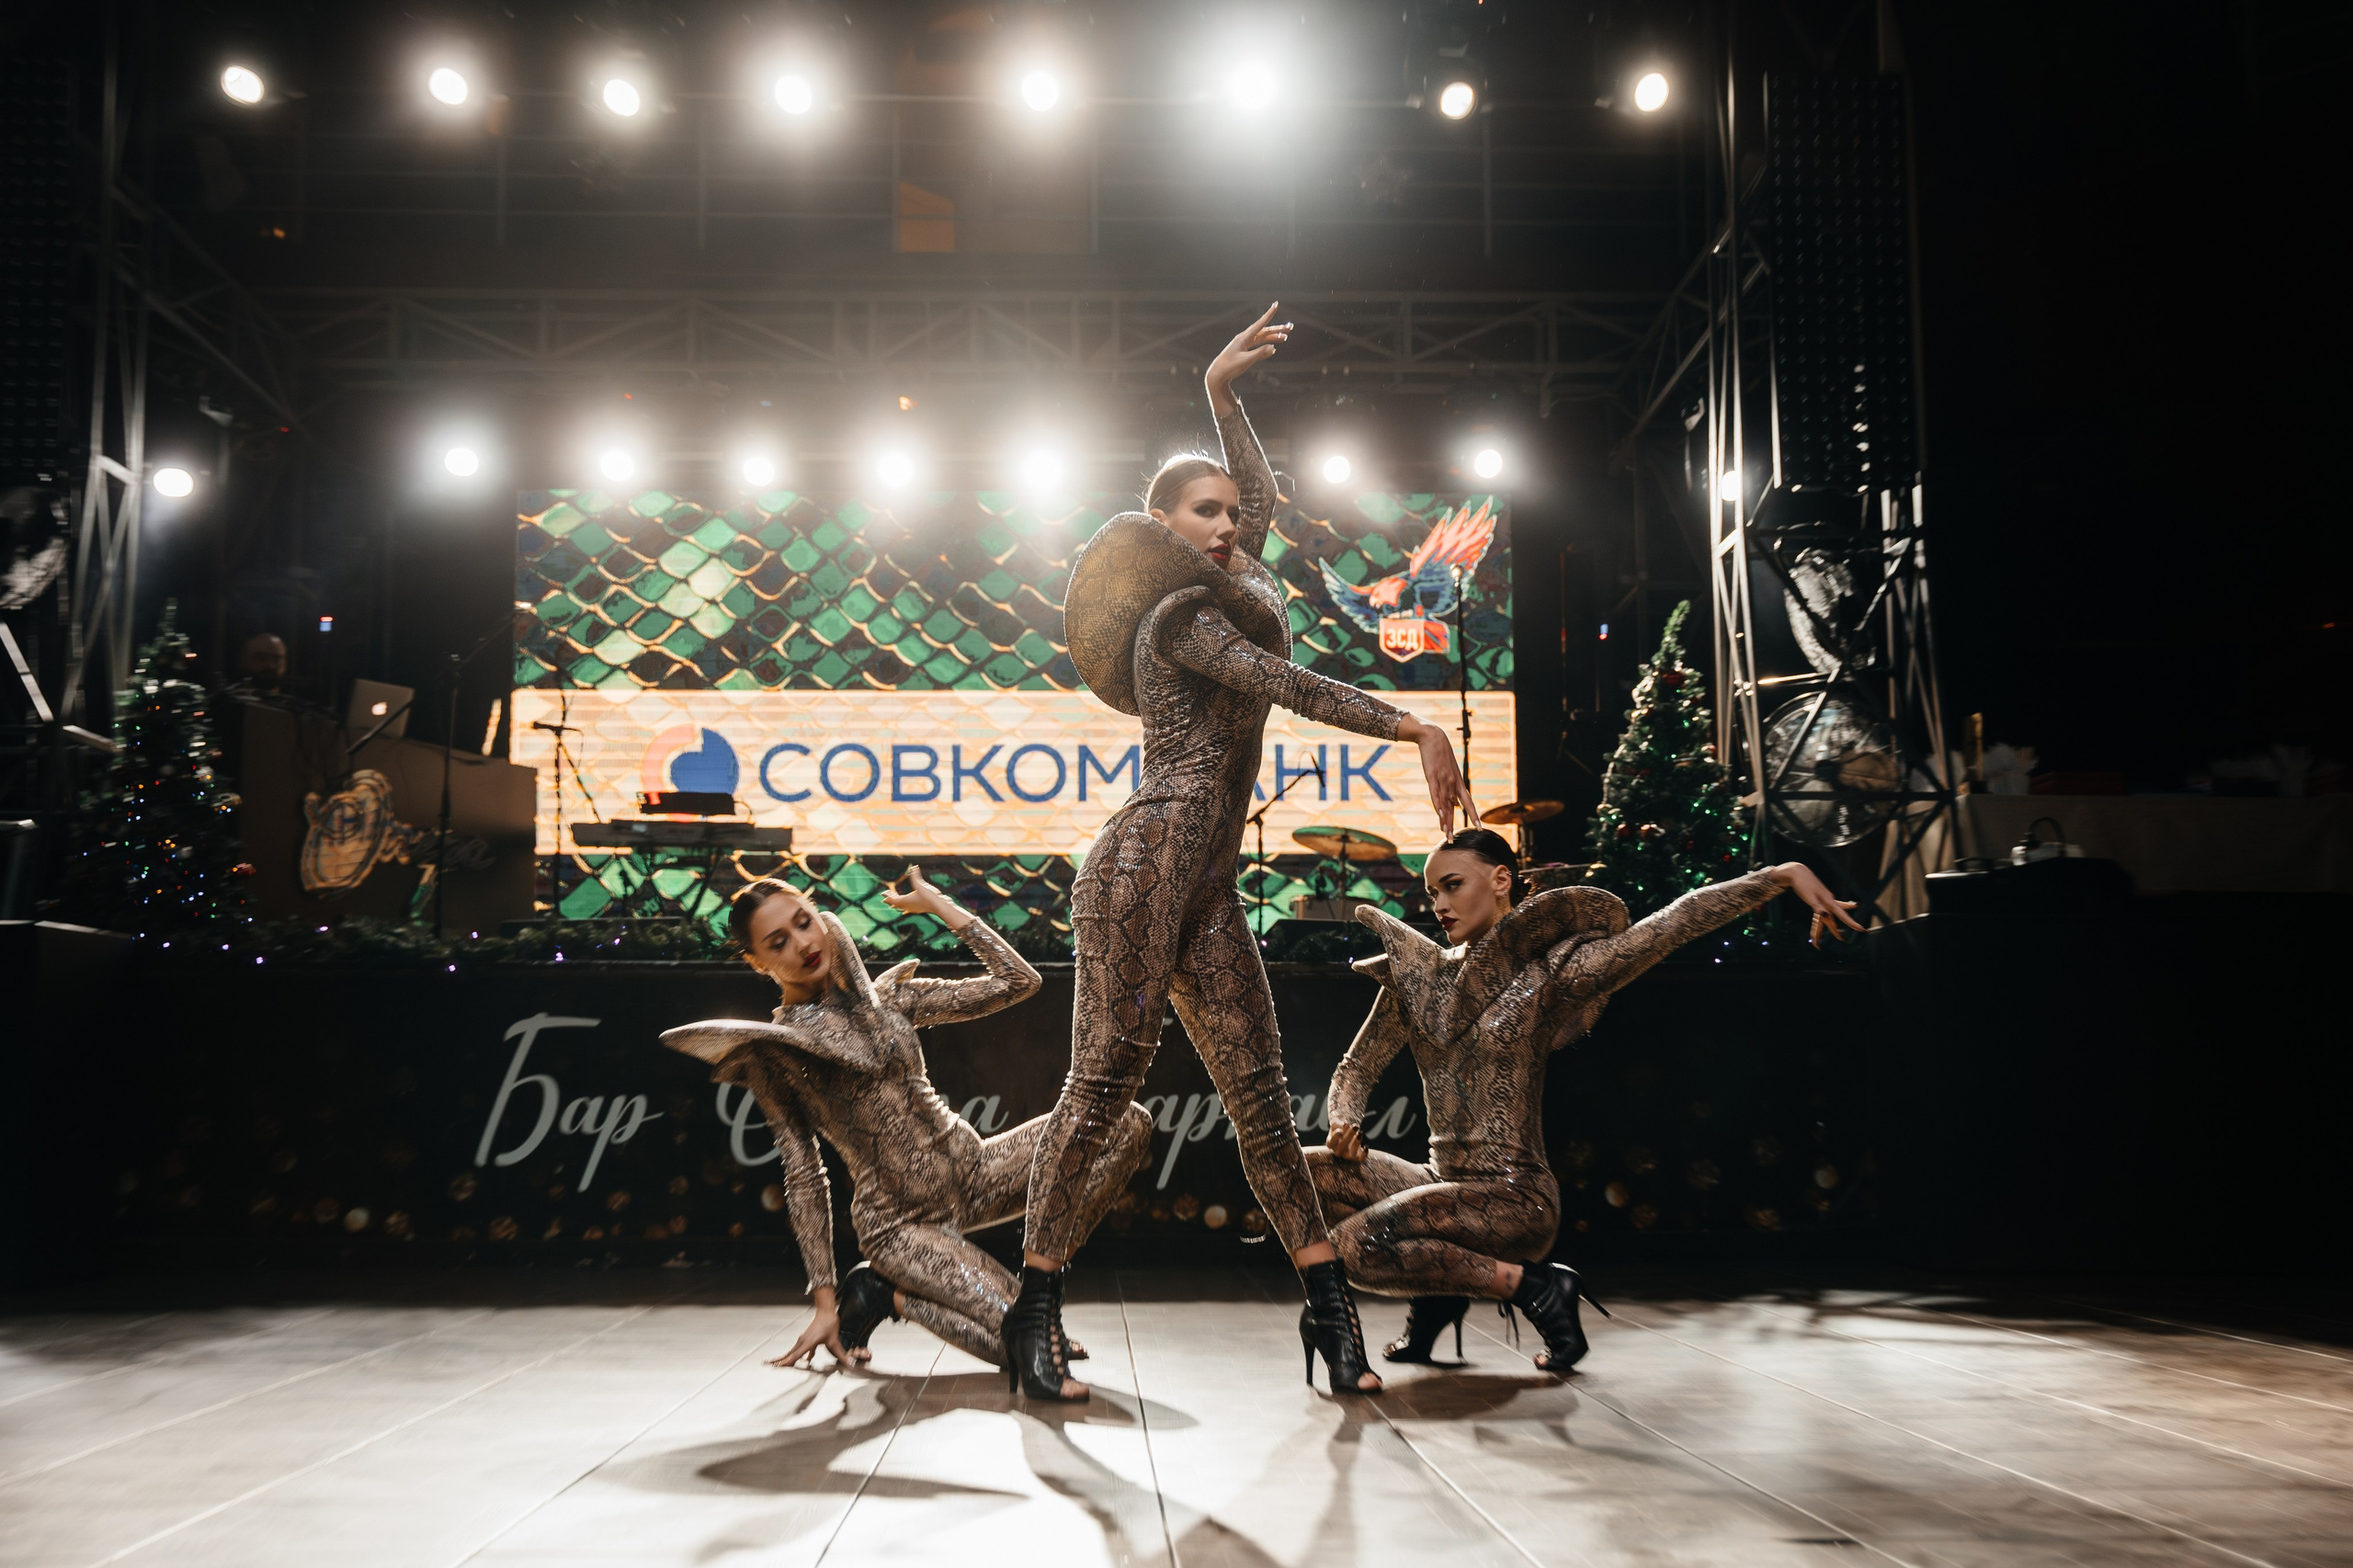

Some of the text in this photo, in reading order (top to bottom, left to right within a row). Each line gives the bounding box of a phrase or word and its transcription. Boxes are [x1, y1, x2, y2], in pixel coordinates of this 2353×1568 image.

[1386, 629, 1418, 651] ЗСД
[759, 743, 1392, 802] СОВКОМНК
[474, 1012, 665, 1192] Бар
